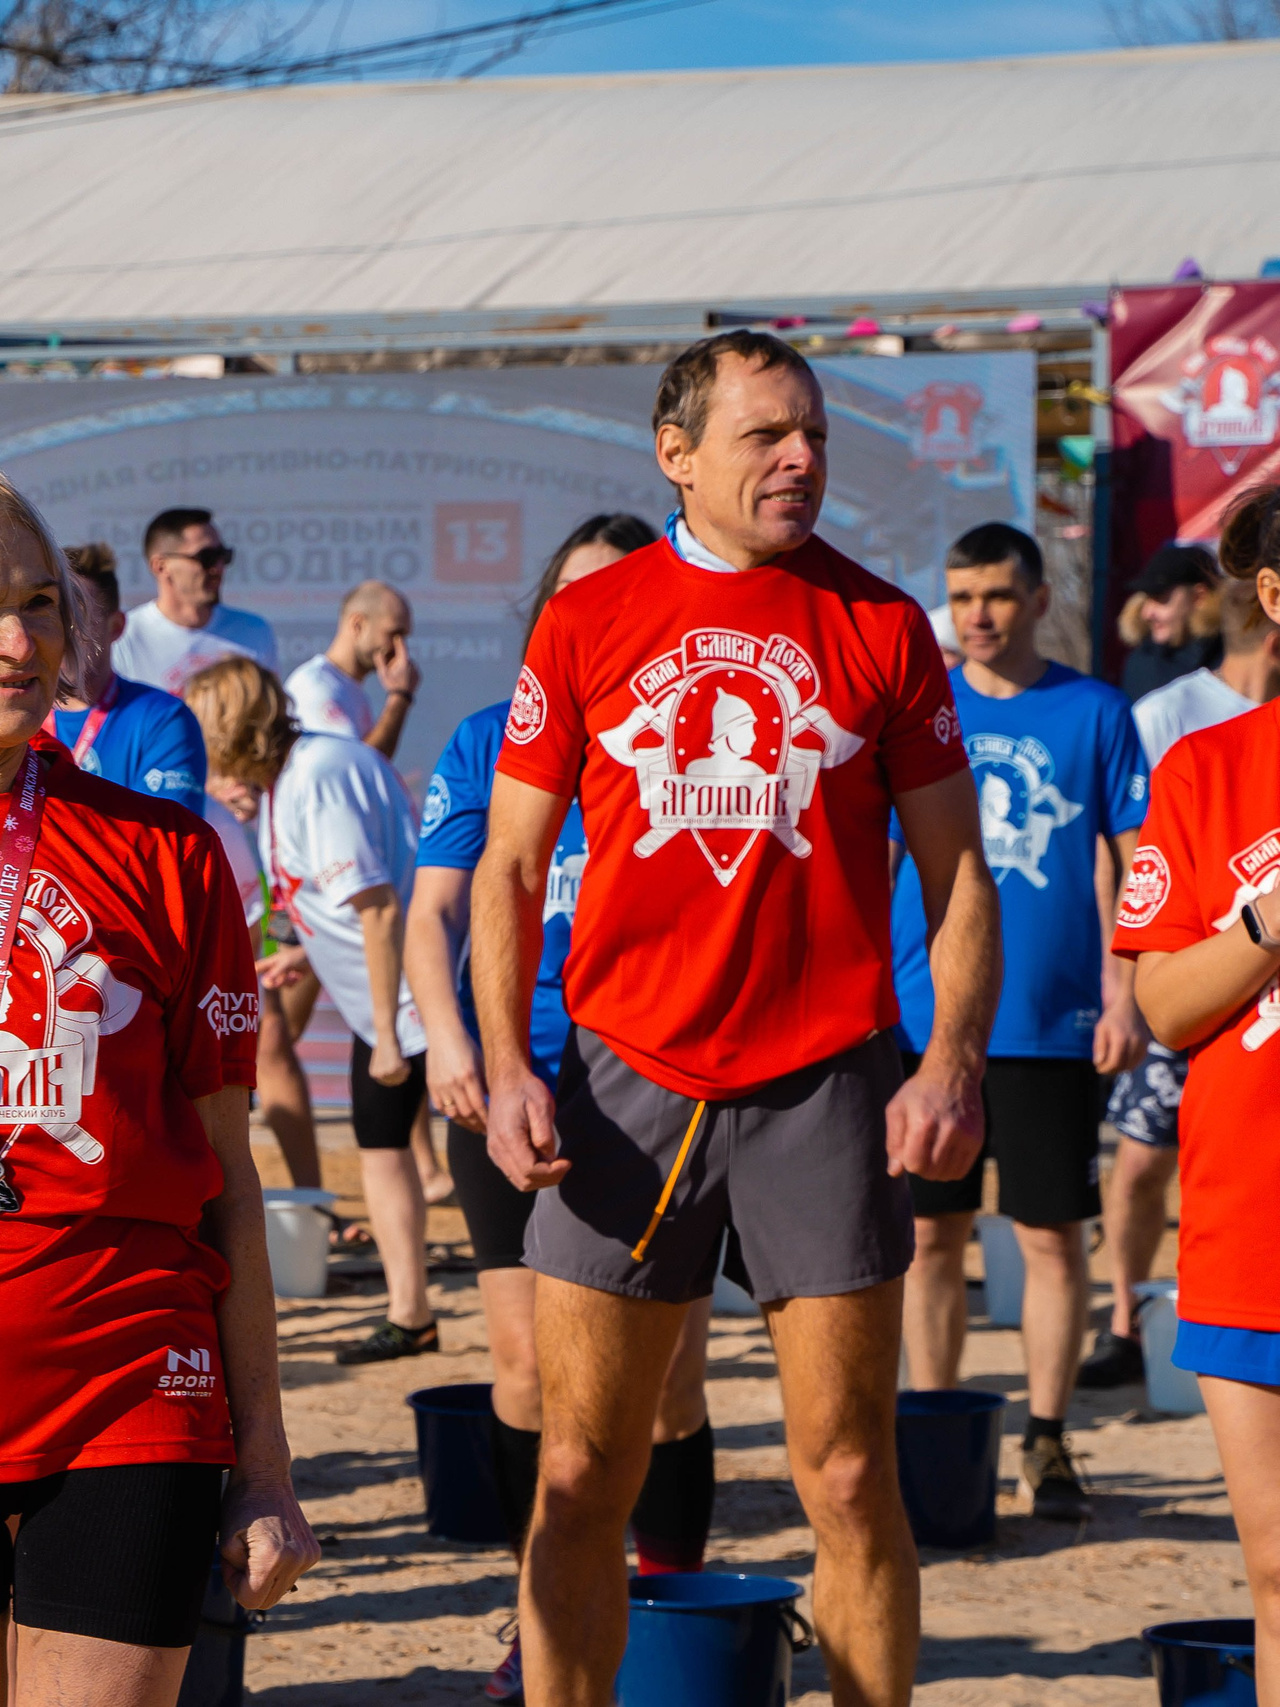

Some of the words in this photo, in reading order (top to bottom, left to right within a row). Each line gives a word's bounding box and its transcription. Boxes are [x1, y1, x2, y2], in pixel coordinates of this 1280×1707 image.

[444, 518, 509, 562] 13
[661, 778, 790, 817] ЯРОПОЛК
[2, 863, 21, 896] ГДЕ?
[24, 874, 81, 929] ДОЛГ
[219, 1013, 258, 1036] ДОМ
[40, 1109, 66, 1119] КЛУБ
[157, 1375, 216, 1388] SPORT
